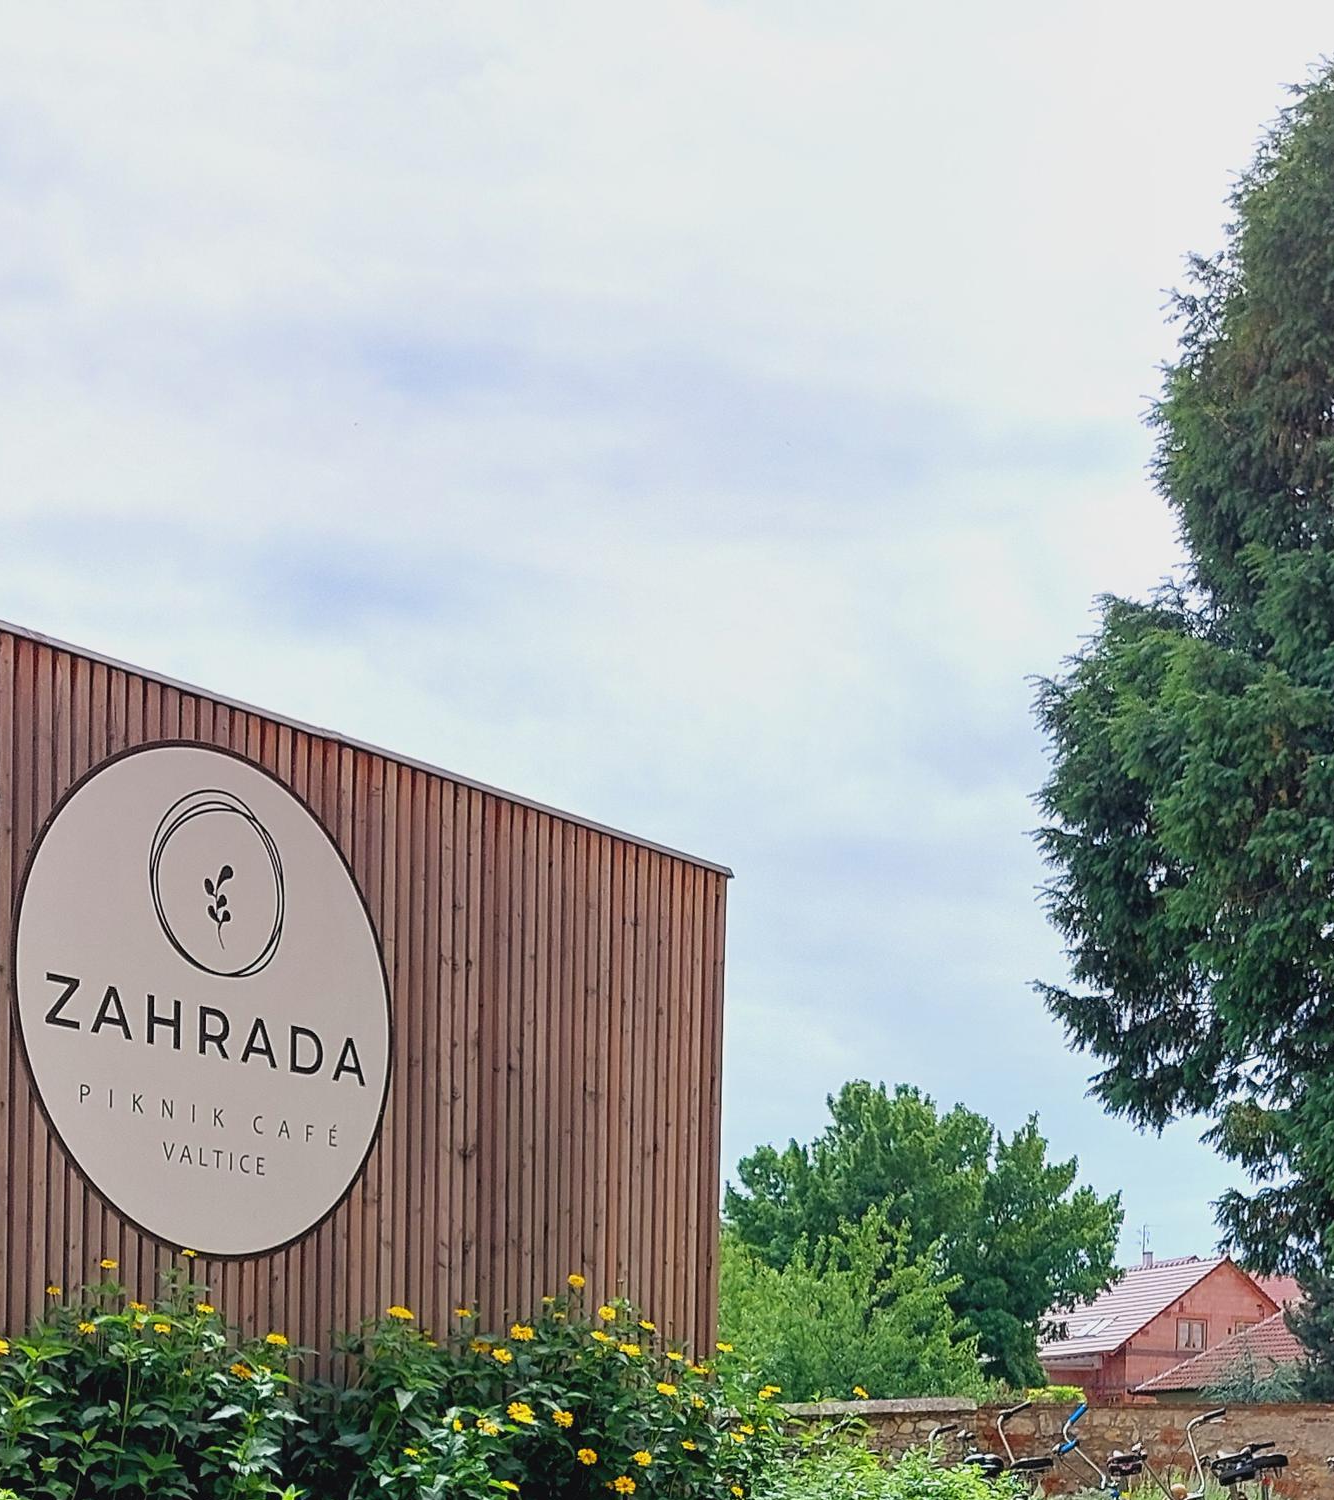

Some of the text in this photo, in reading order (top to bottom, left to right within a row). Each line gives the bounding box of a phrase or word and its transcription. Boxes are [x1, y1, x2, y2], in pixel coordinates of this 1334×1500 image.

[44, 972, 366, 1087] ZAHRADA
[79, 1084, 338, 1147] PIKNIK CAFÉ
[162, 1141, 266, 1176] VALTICE
